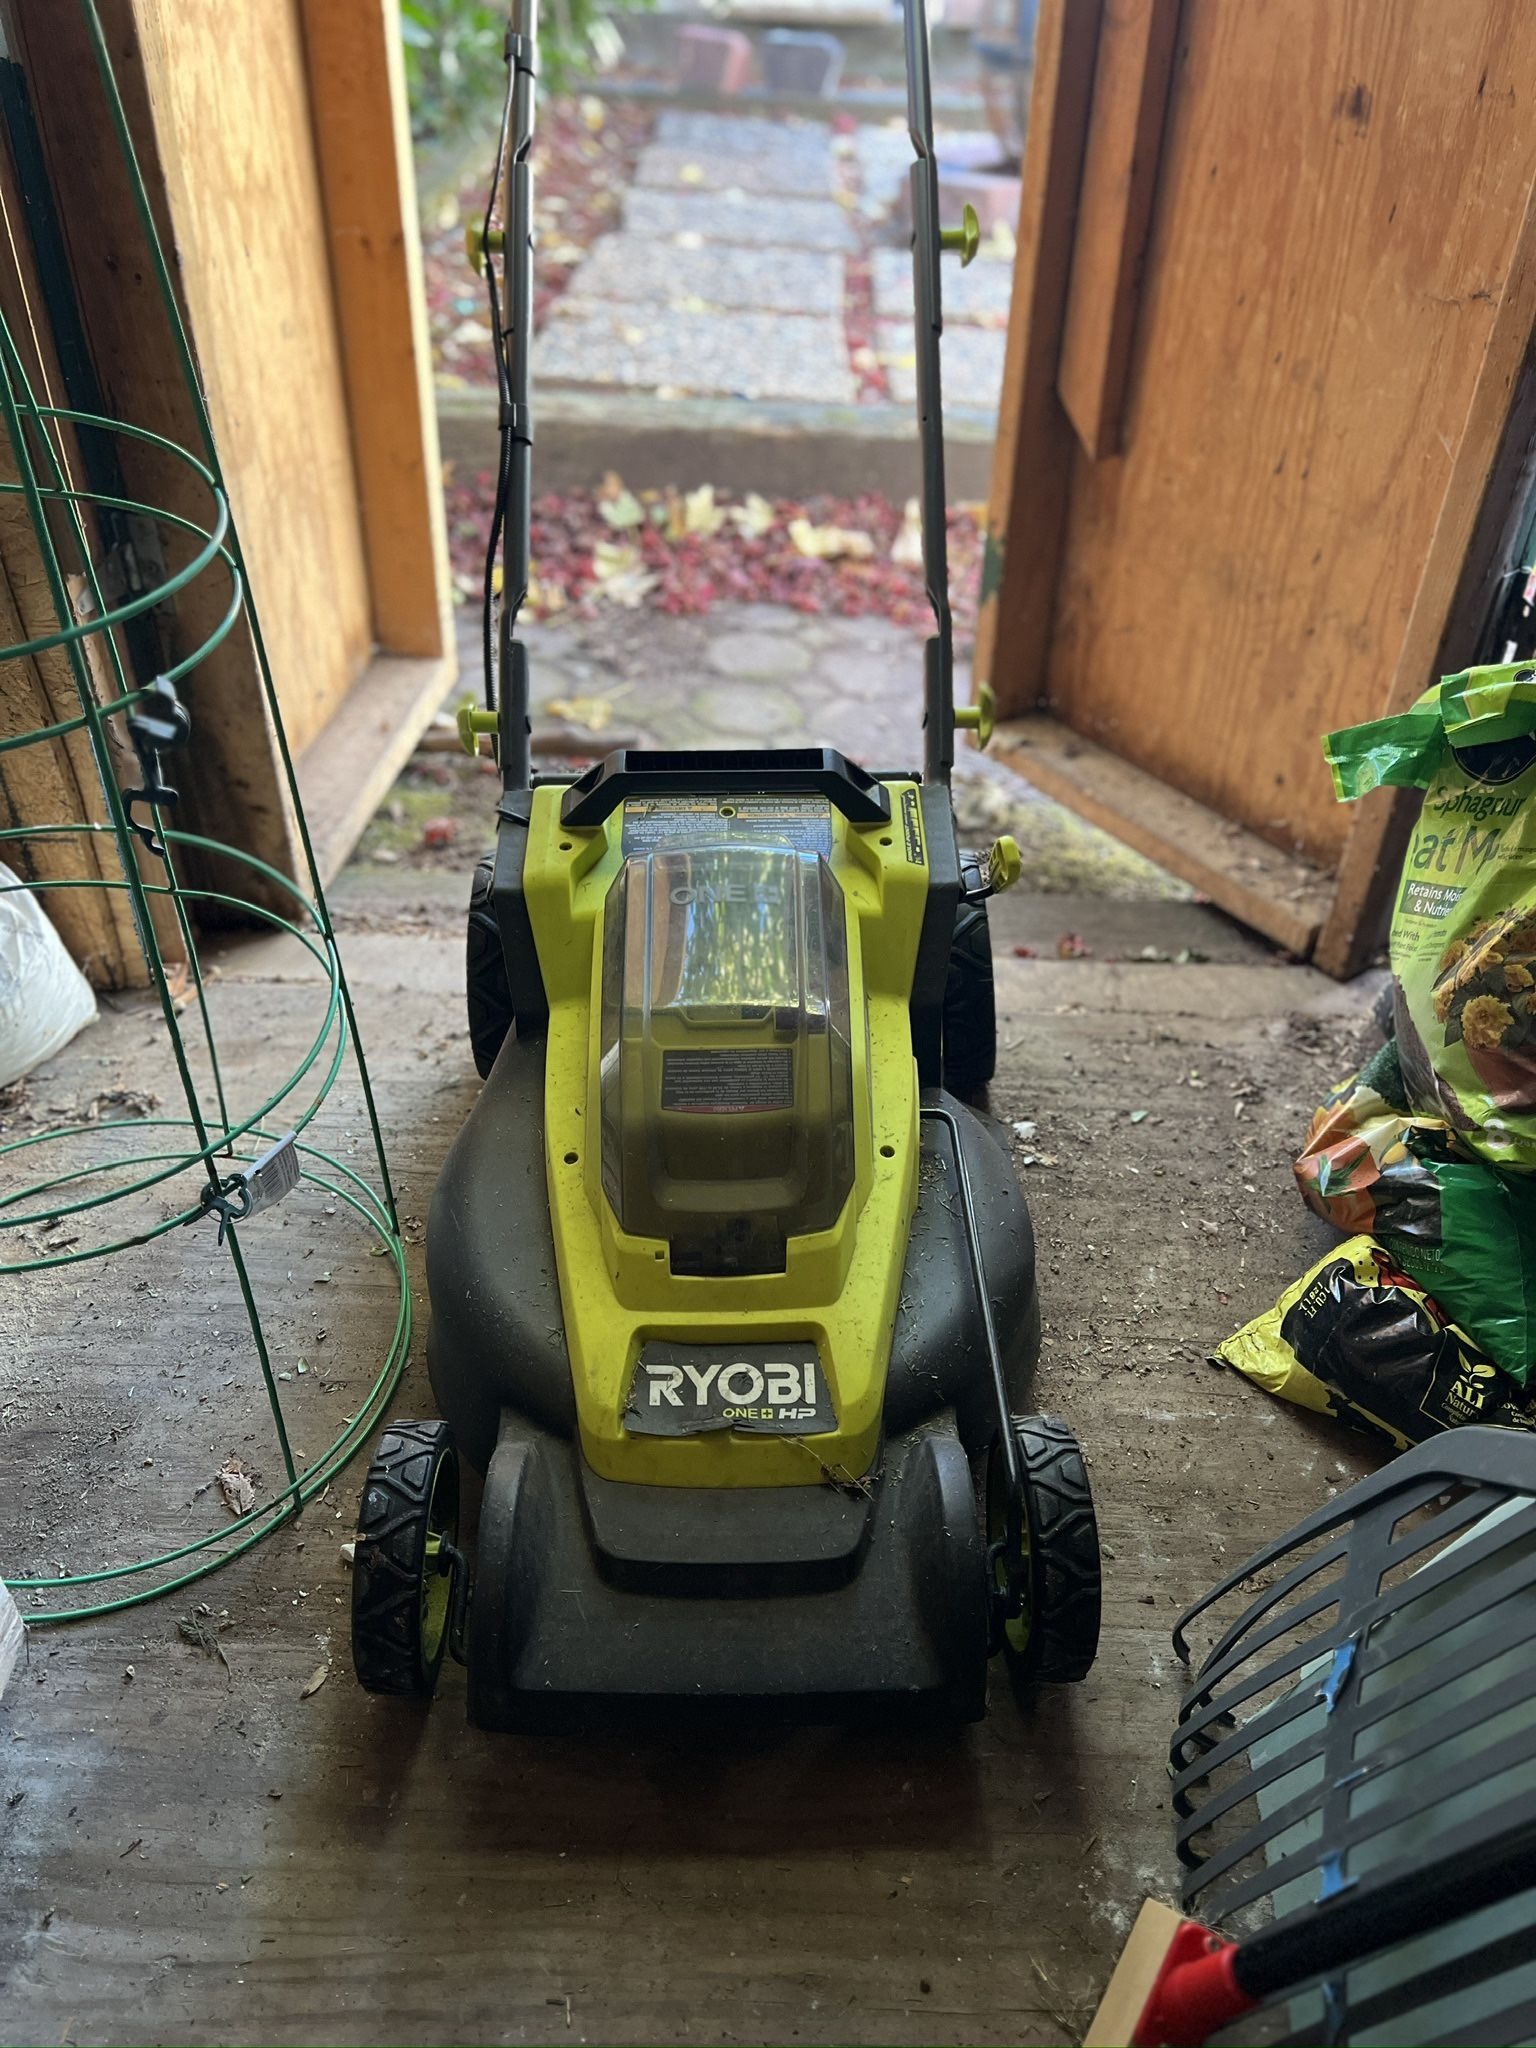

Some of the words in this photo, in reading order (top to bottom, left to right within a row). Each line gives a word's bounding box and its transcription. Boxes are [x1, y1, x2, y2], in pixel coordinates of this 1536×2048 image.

[1408, 883, 1443, 899] Retains
[1413, 899, 1422, 912] &
[646, 1363, 816, 1406] RYOBI
[1445, 1391, 1475, 1416] Natur
[778, 1408, 816, 1419] HP
